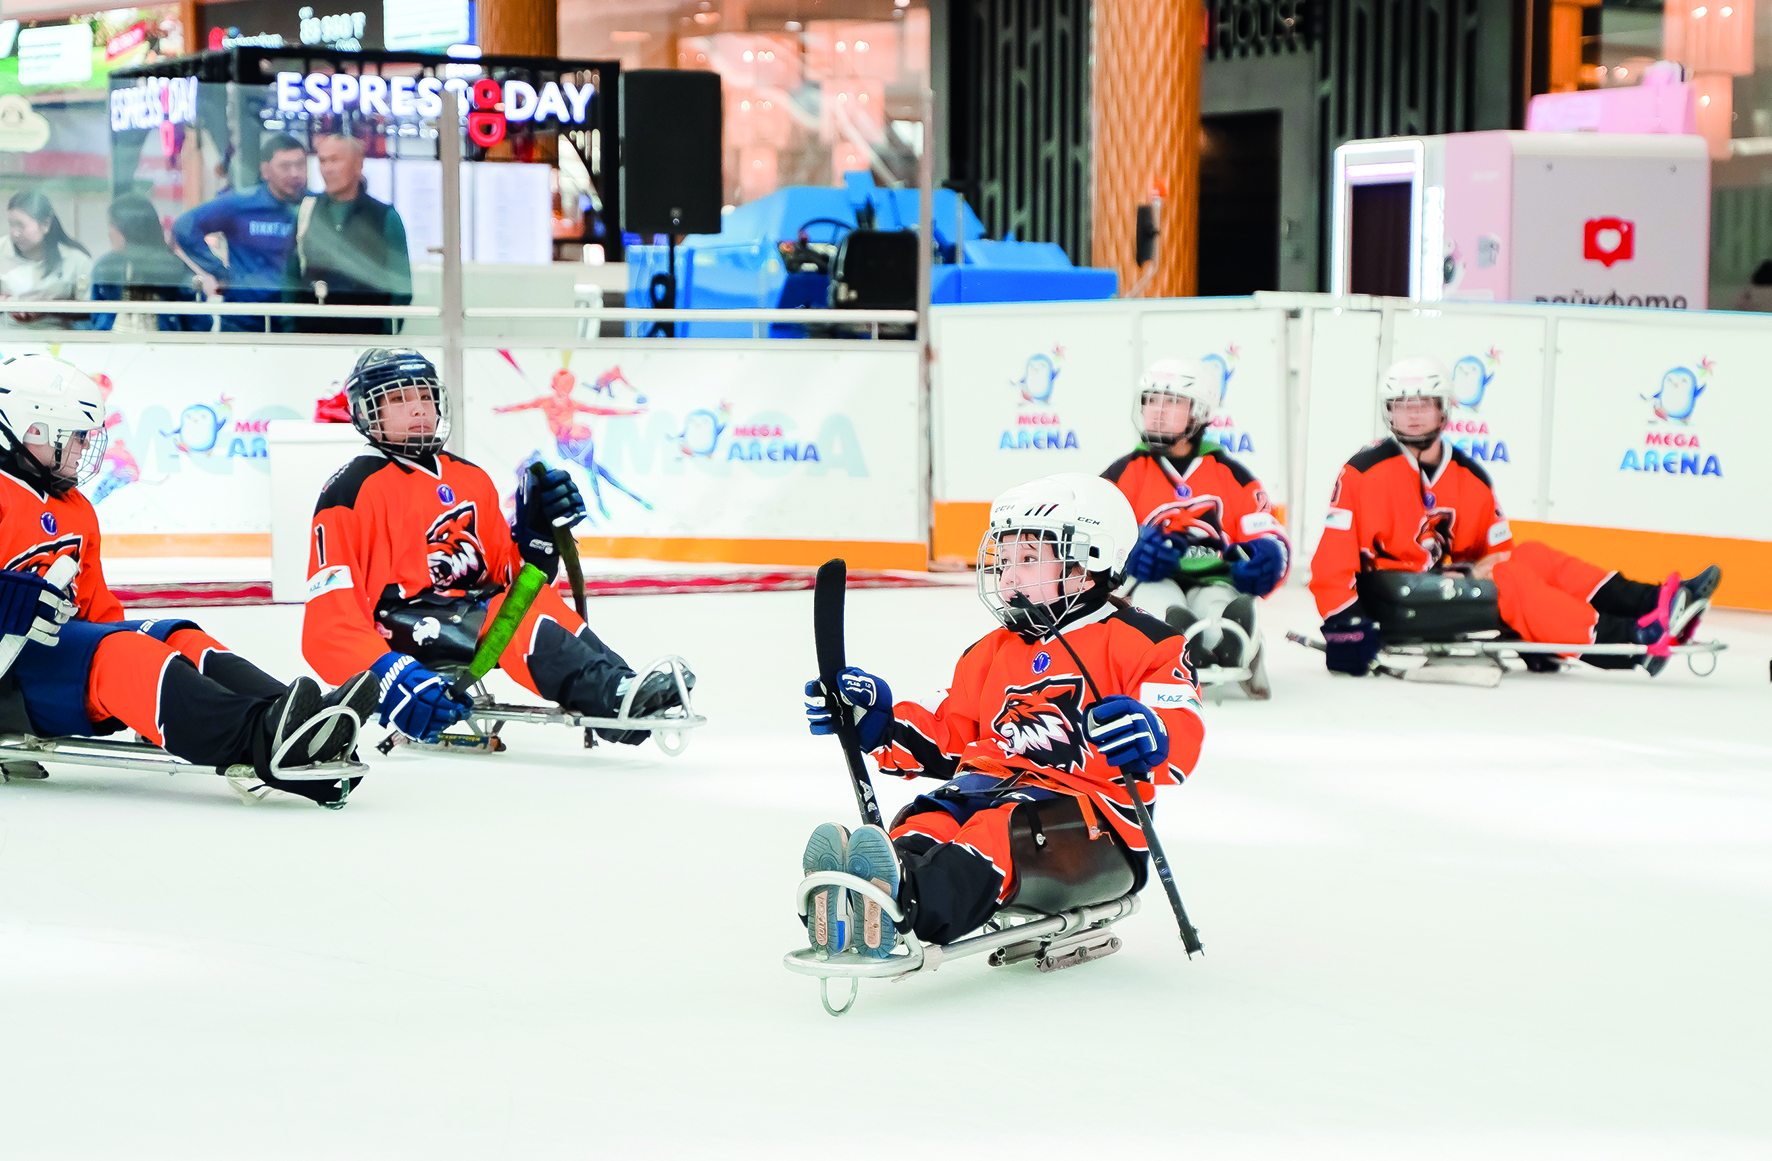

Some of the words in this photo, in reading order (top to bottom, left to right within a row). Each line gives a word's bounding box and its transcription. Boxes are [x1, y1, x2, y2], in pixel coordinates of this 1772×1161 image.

[1017, 414, 1060, 425] MEGA
[733, 425, 783, 437] MEGA
[999, 430, 1079, 450] ARENA
[1645, 432, 1700, 448] MEGA
[727, 440, 820, 462] ARENA
[1619, 448, 1724, 477] ARENA
[1077, 516, 1101, 526] CCM
[315, 524, 327, 567] 1
[1157, 693, 1183, 702] KAZ
